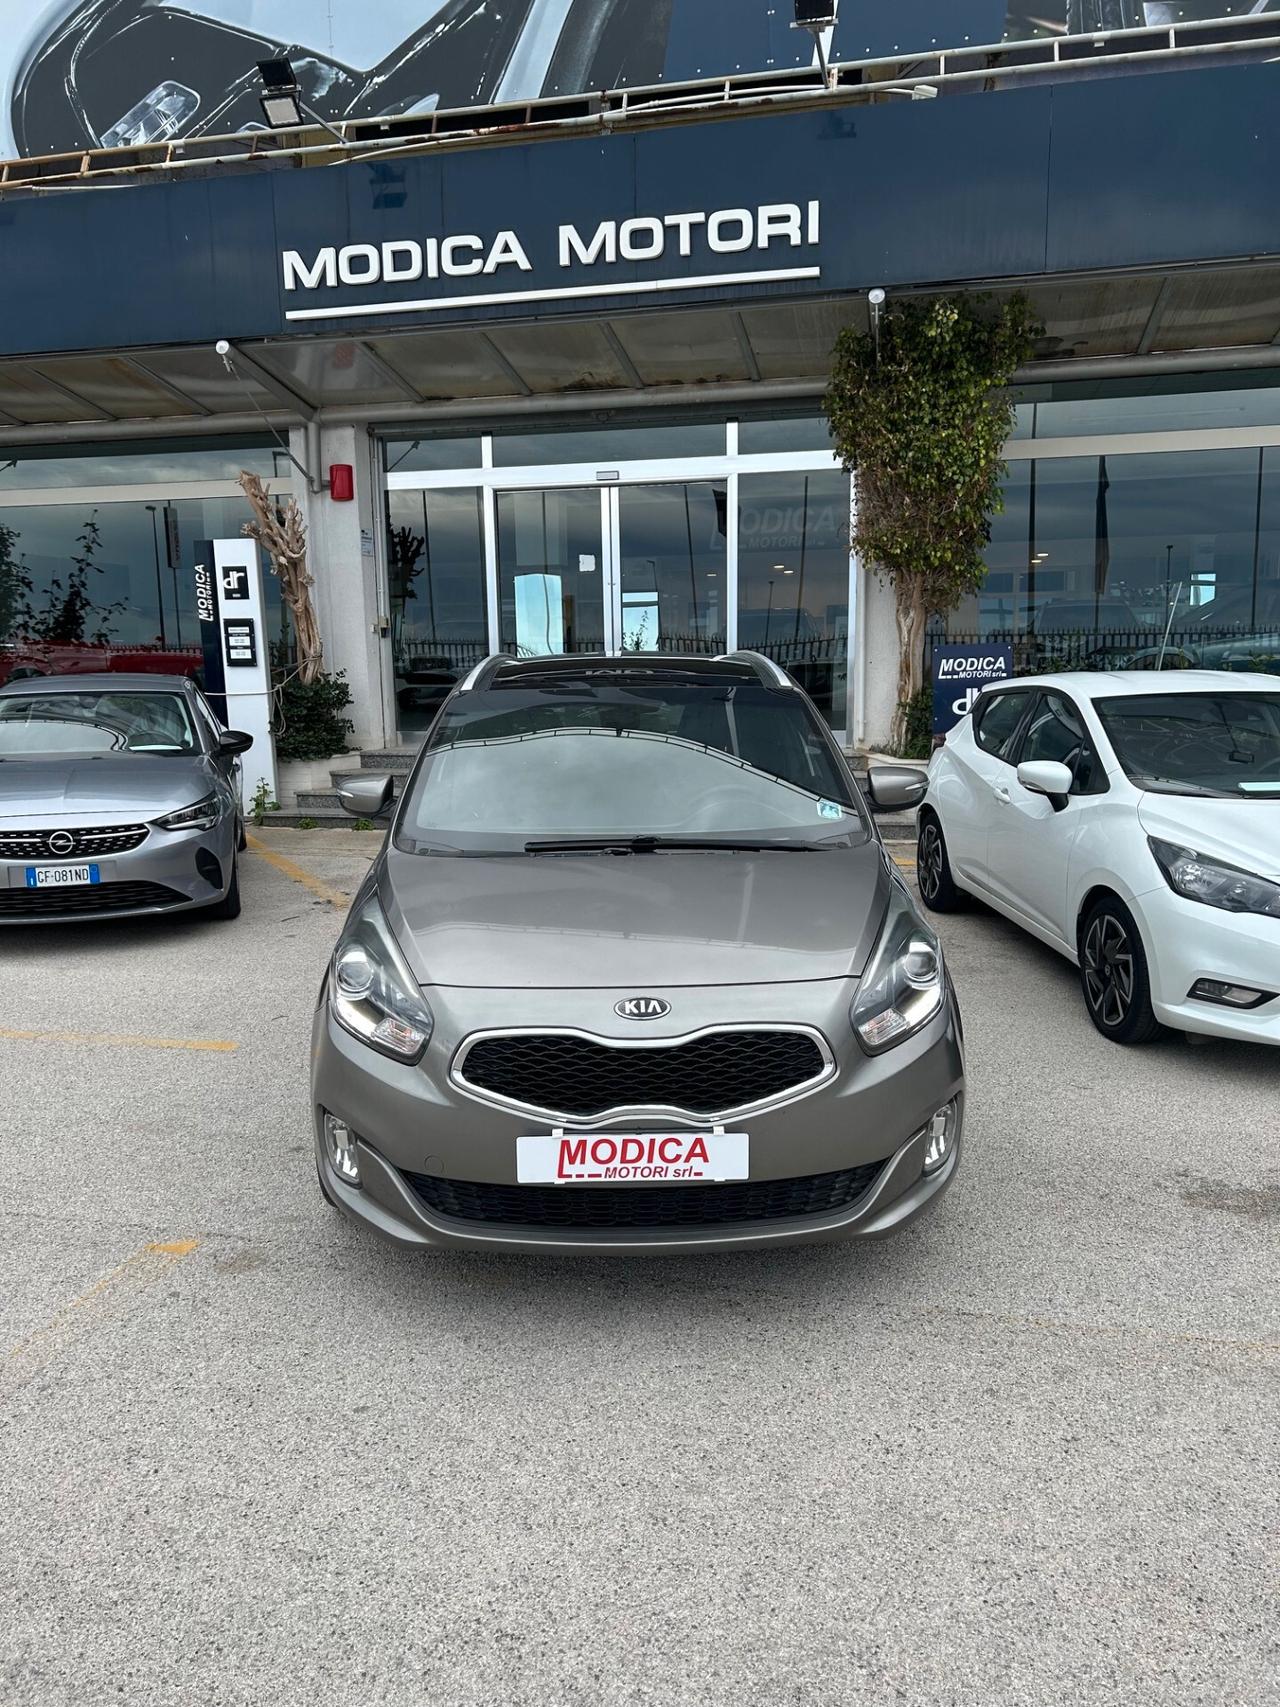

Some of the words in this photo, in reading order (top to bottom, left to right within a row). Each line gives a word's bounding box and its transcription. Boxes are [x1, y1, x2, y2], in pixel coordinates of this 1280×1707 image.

[283, 230, 532, 291] MODICA
[558, 200, 820, 268] MOTORI
[194, 563, 211, 621] MODICA
[939, 656, 1005, 672] MODICA
[958, 670, 992, 679] MOTORI
[624, 999, 663, 1014] KIA
[559, 1137, 710, 1166] MODICA
[604, 1166, 668, 1179] MOTORI
[672, 1165, 693, 1178] srl
